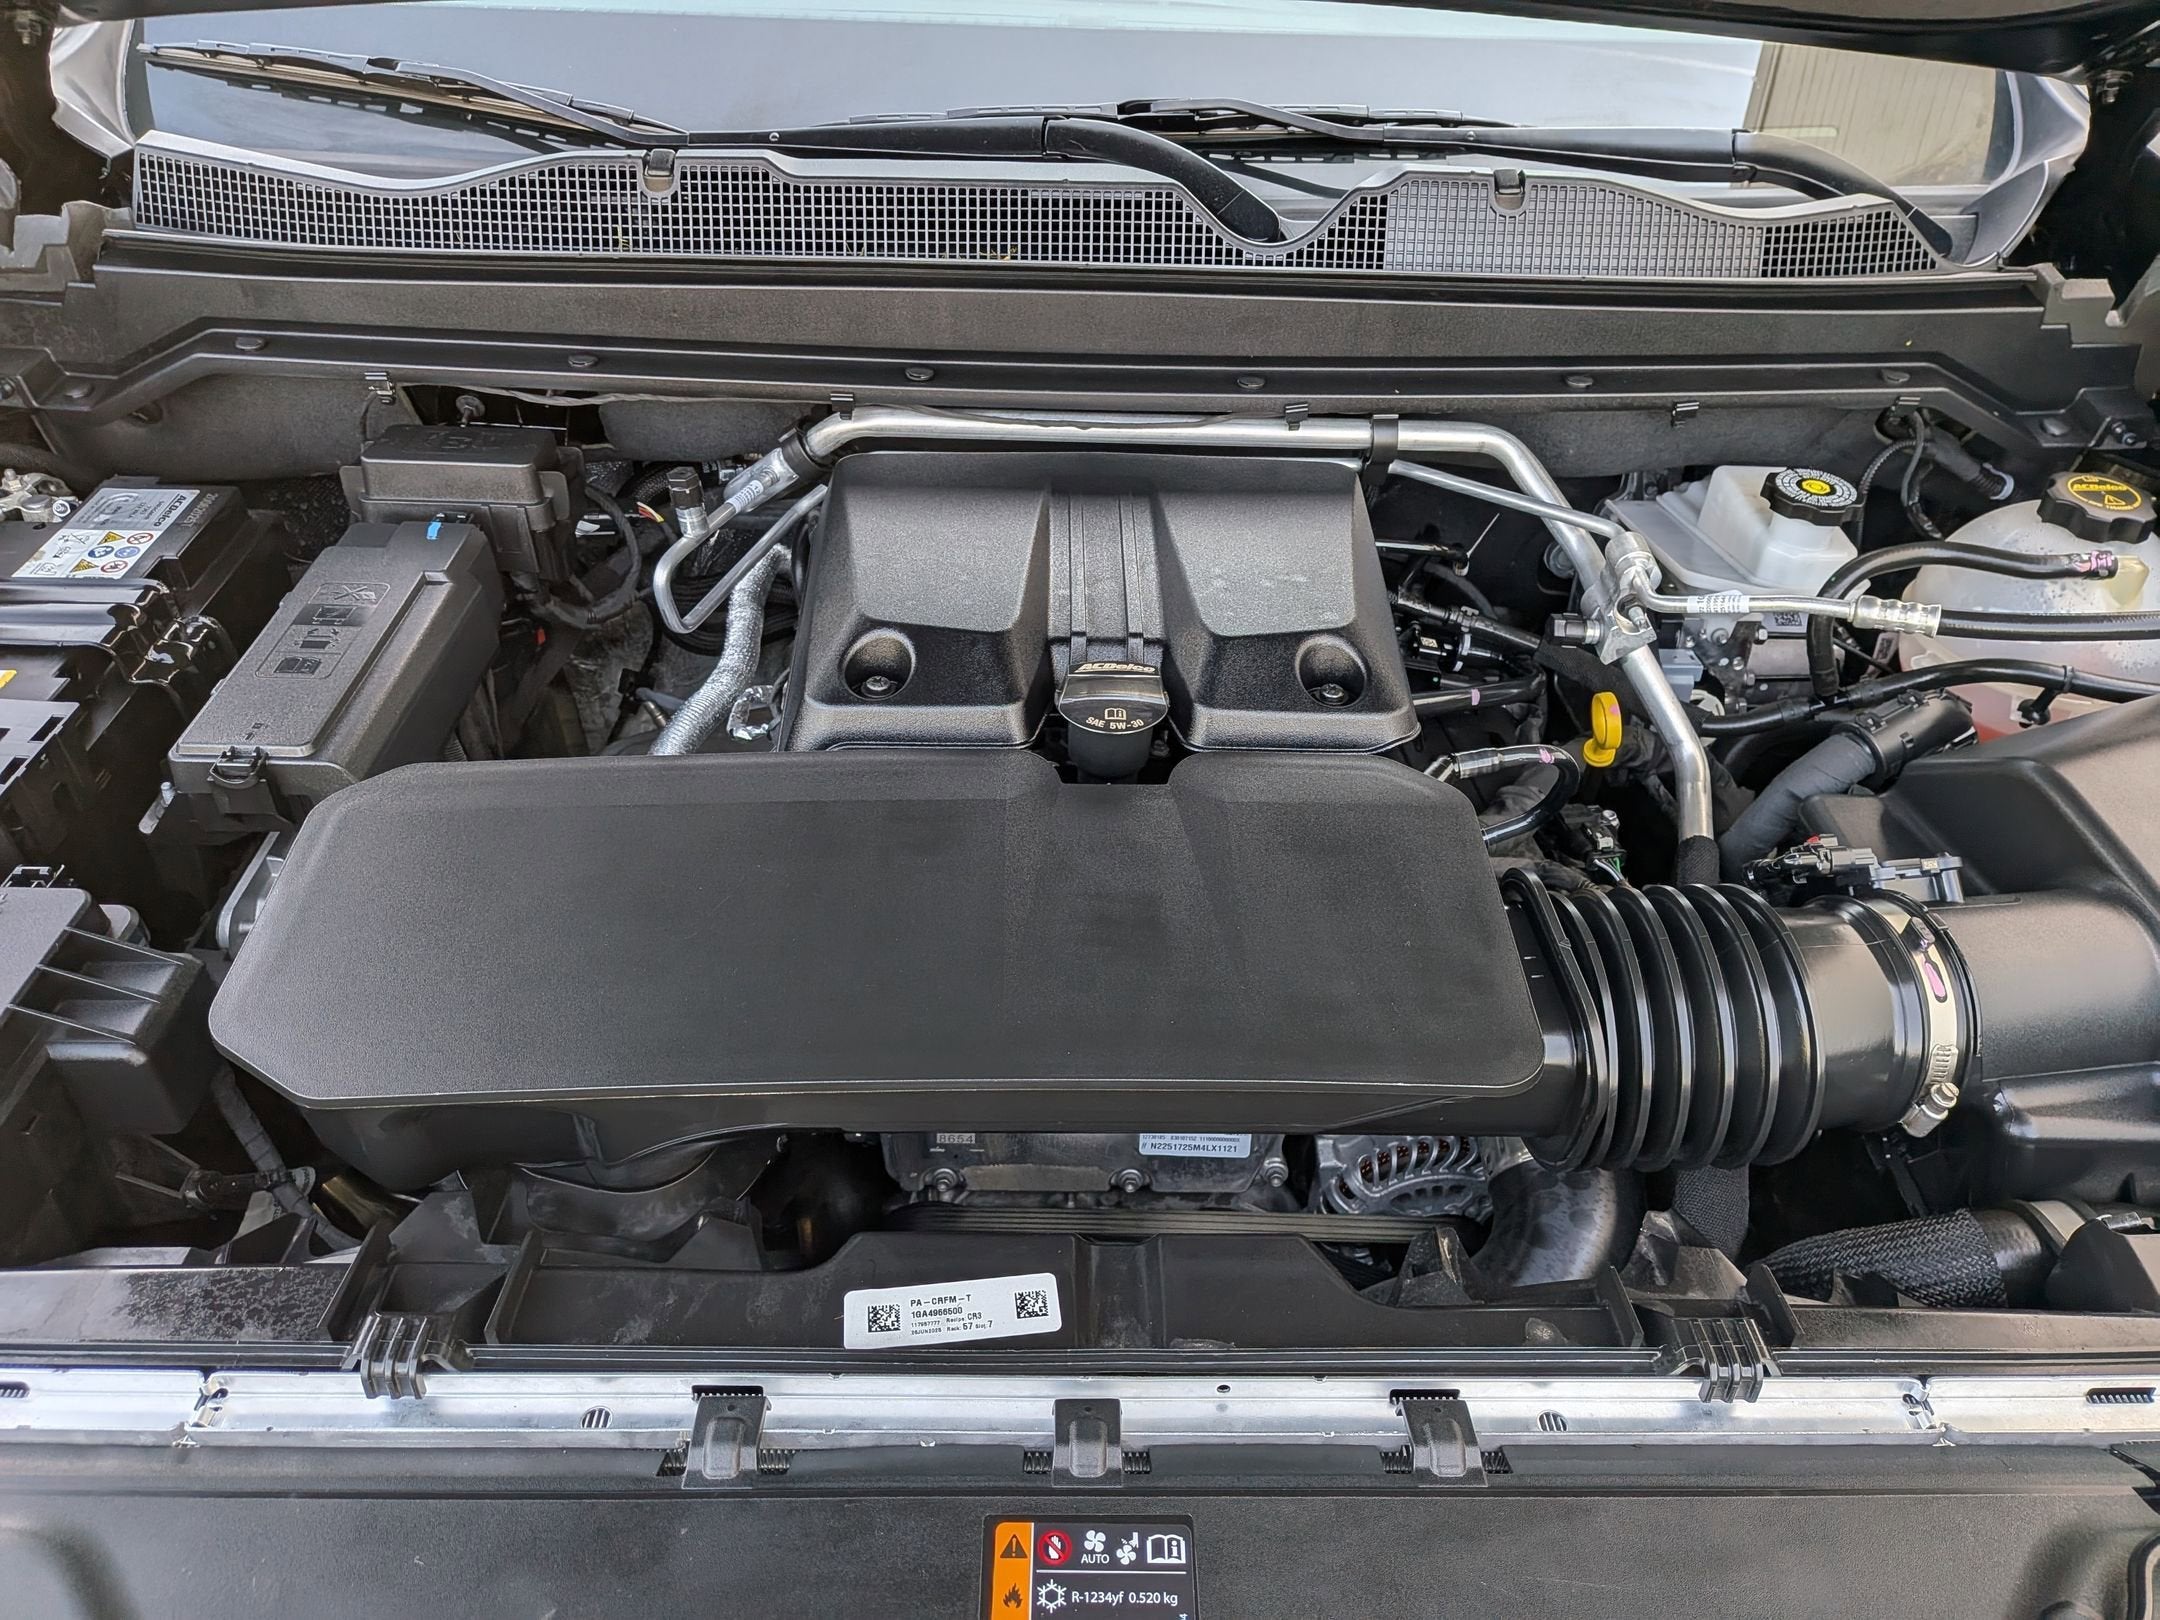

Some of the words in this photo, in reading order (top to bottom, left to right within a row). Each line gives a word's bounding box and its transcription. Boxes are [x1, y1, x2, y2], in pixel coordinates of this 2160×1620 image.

[154, 494, 187, 527] ACDelco
[1076, 662, 1156, 673] ACDelco
[1086, 716, 1106, 728] SAE
[1109, 718, 1144, 730] 5W-30
[967, 1312, 982, 1320] CR3
[987, 1320, 993, 1328] 7
[1081, 1554, 1110, 1564] AUTO
[1071, 1591, 1125, 1606] R-1234yf
[1128, 1591, 1162, 1604] 0.520
[1163, 1591, 1178, 1607] kg
